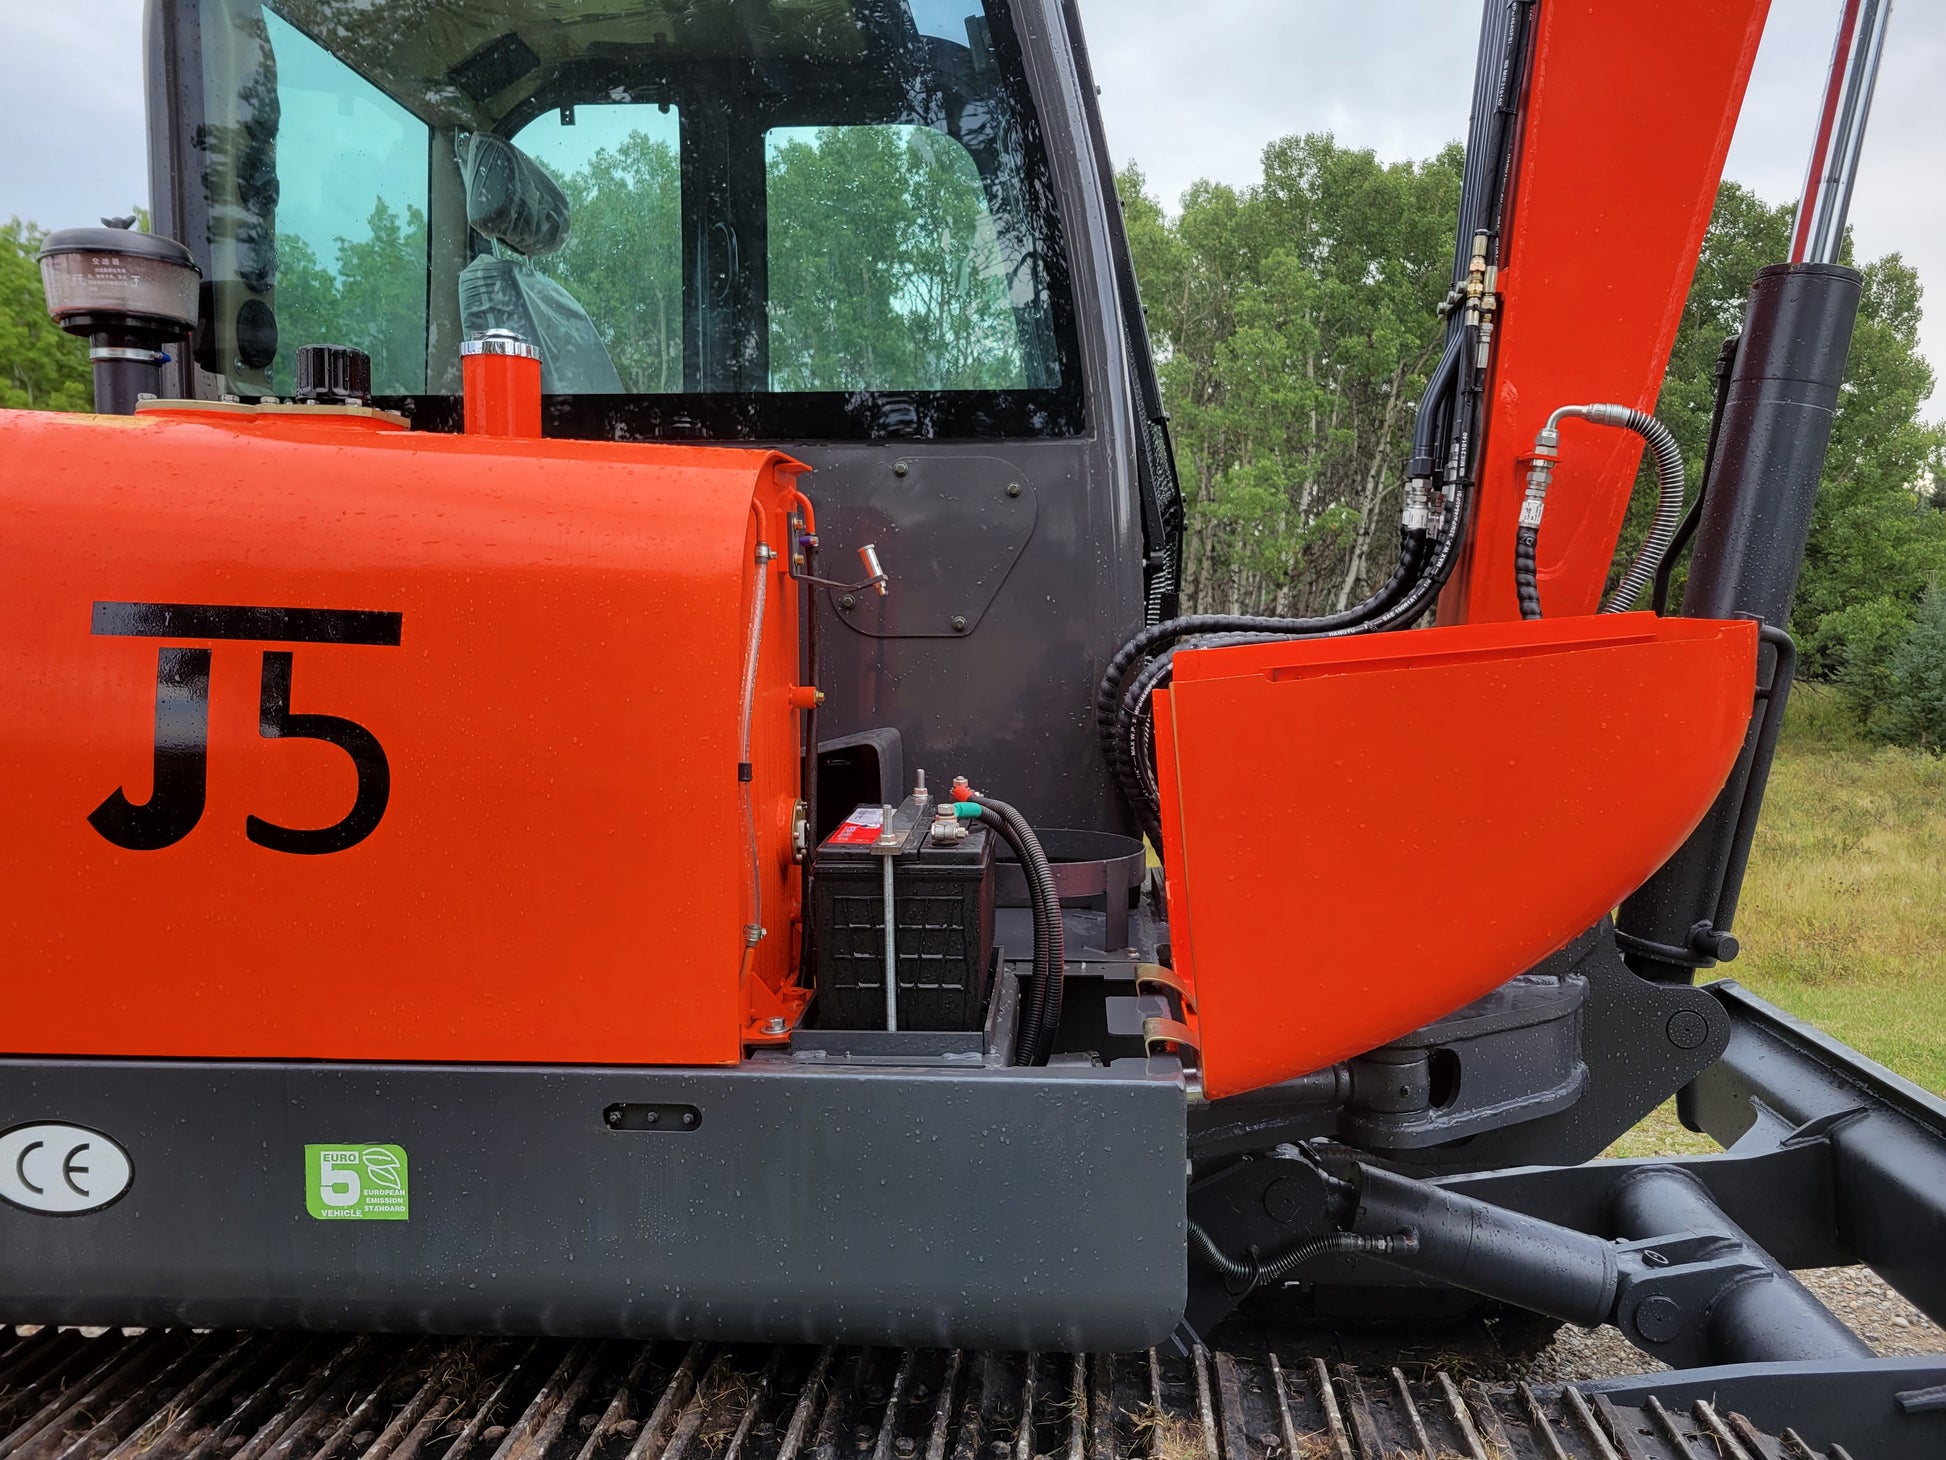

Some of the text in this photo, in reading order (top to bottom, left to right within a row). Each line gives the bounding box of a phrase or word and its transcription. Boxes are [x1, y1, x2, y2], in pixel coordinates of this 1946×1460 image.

[1436, 553, 1447, 568] MAX
[323, 1153, 357, 1163] EURO
[16, 1140, 90, 1198] CE
[321, 1162, 361, 1207] 5
[321, 1209, 362, 1217] VEHICLE
